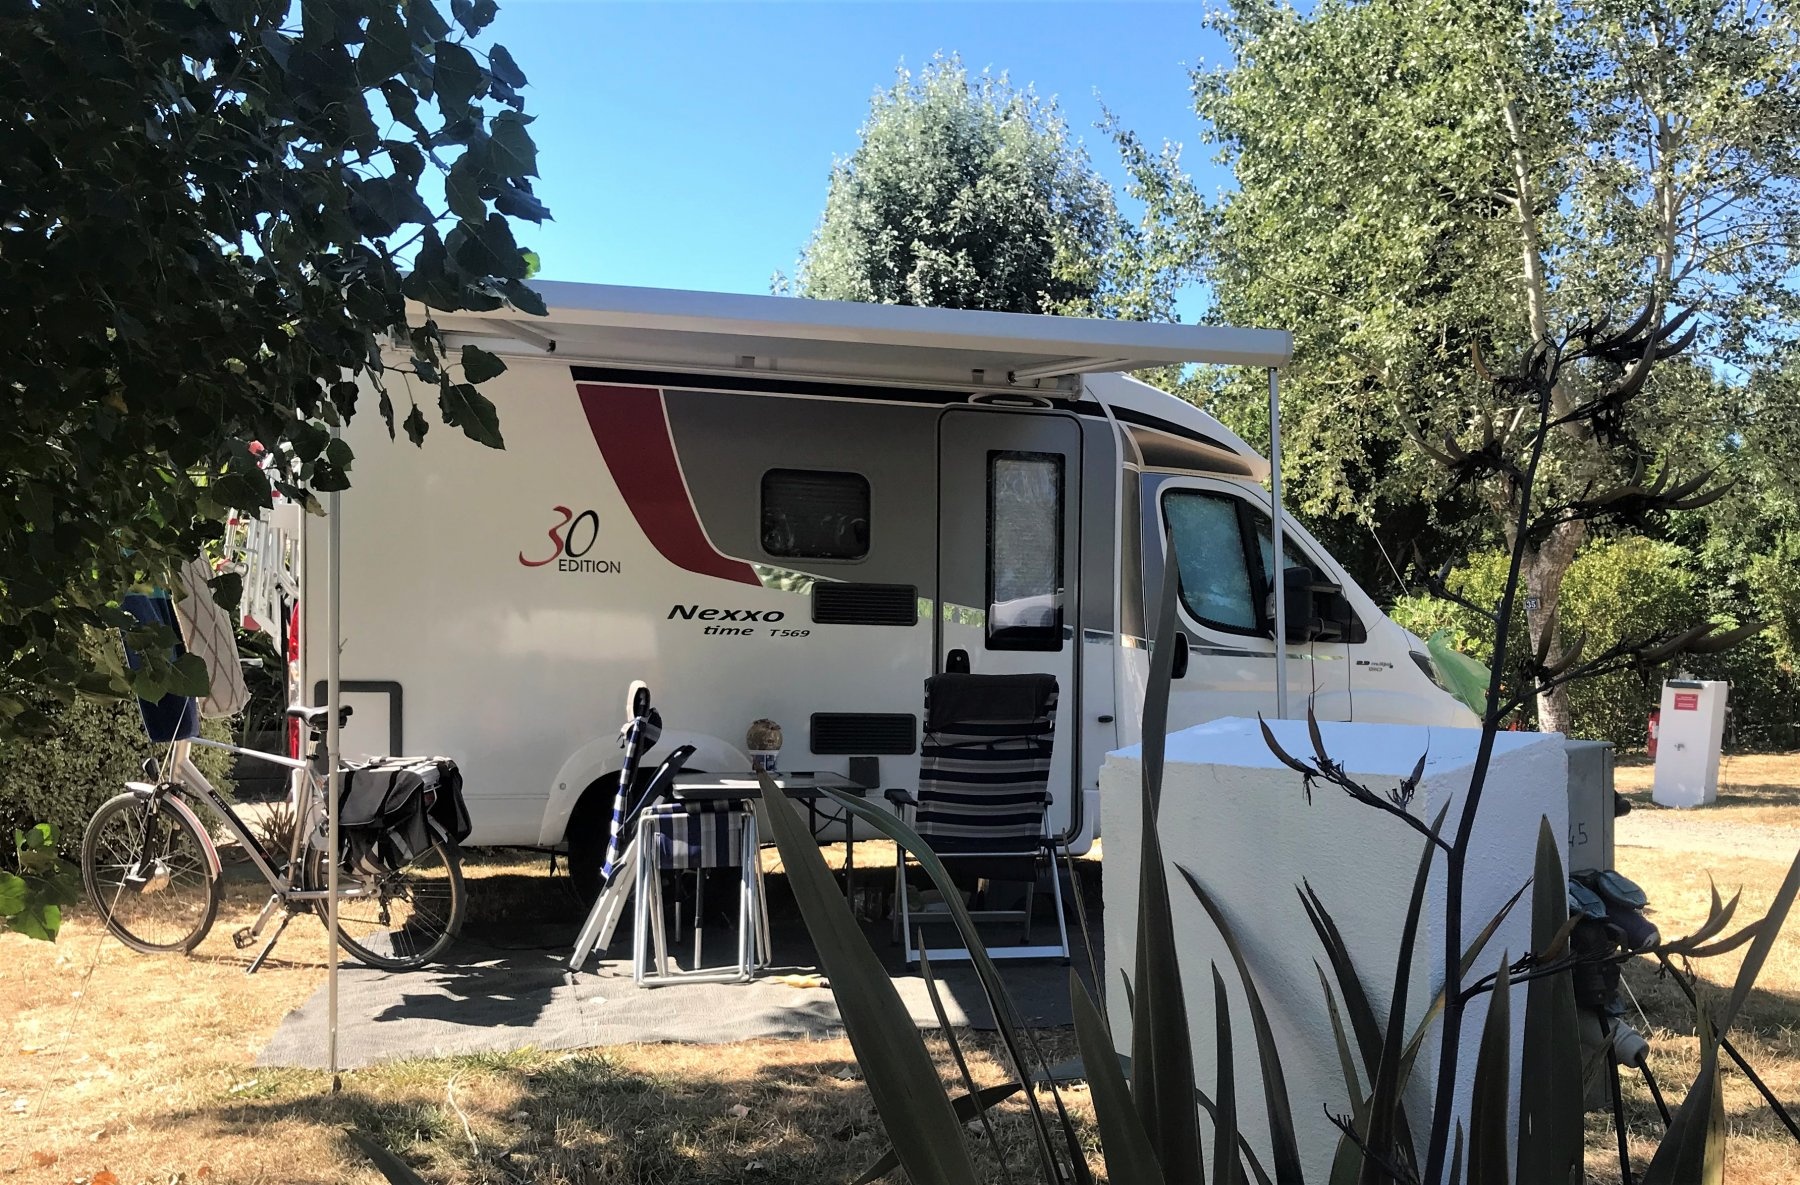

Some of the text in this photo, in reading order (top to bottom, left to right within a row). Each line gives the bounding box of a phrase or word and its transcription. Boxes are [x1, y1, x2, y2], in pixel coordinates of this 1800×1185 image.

[519, 505, 600, 567] 30
[558, 559, 621, 574] EDITION
[667, 604, 785, 623] Nexxo
[703, 625, 811, 638] time T569
